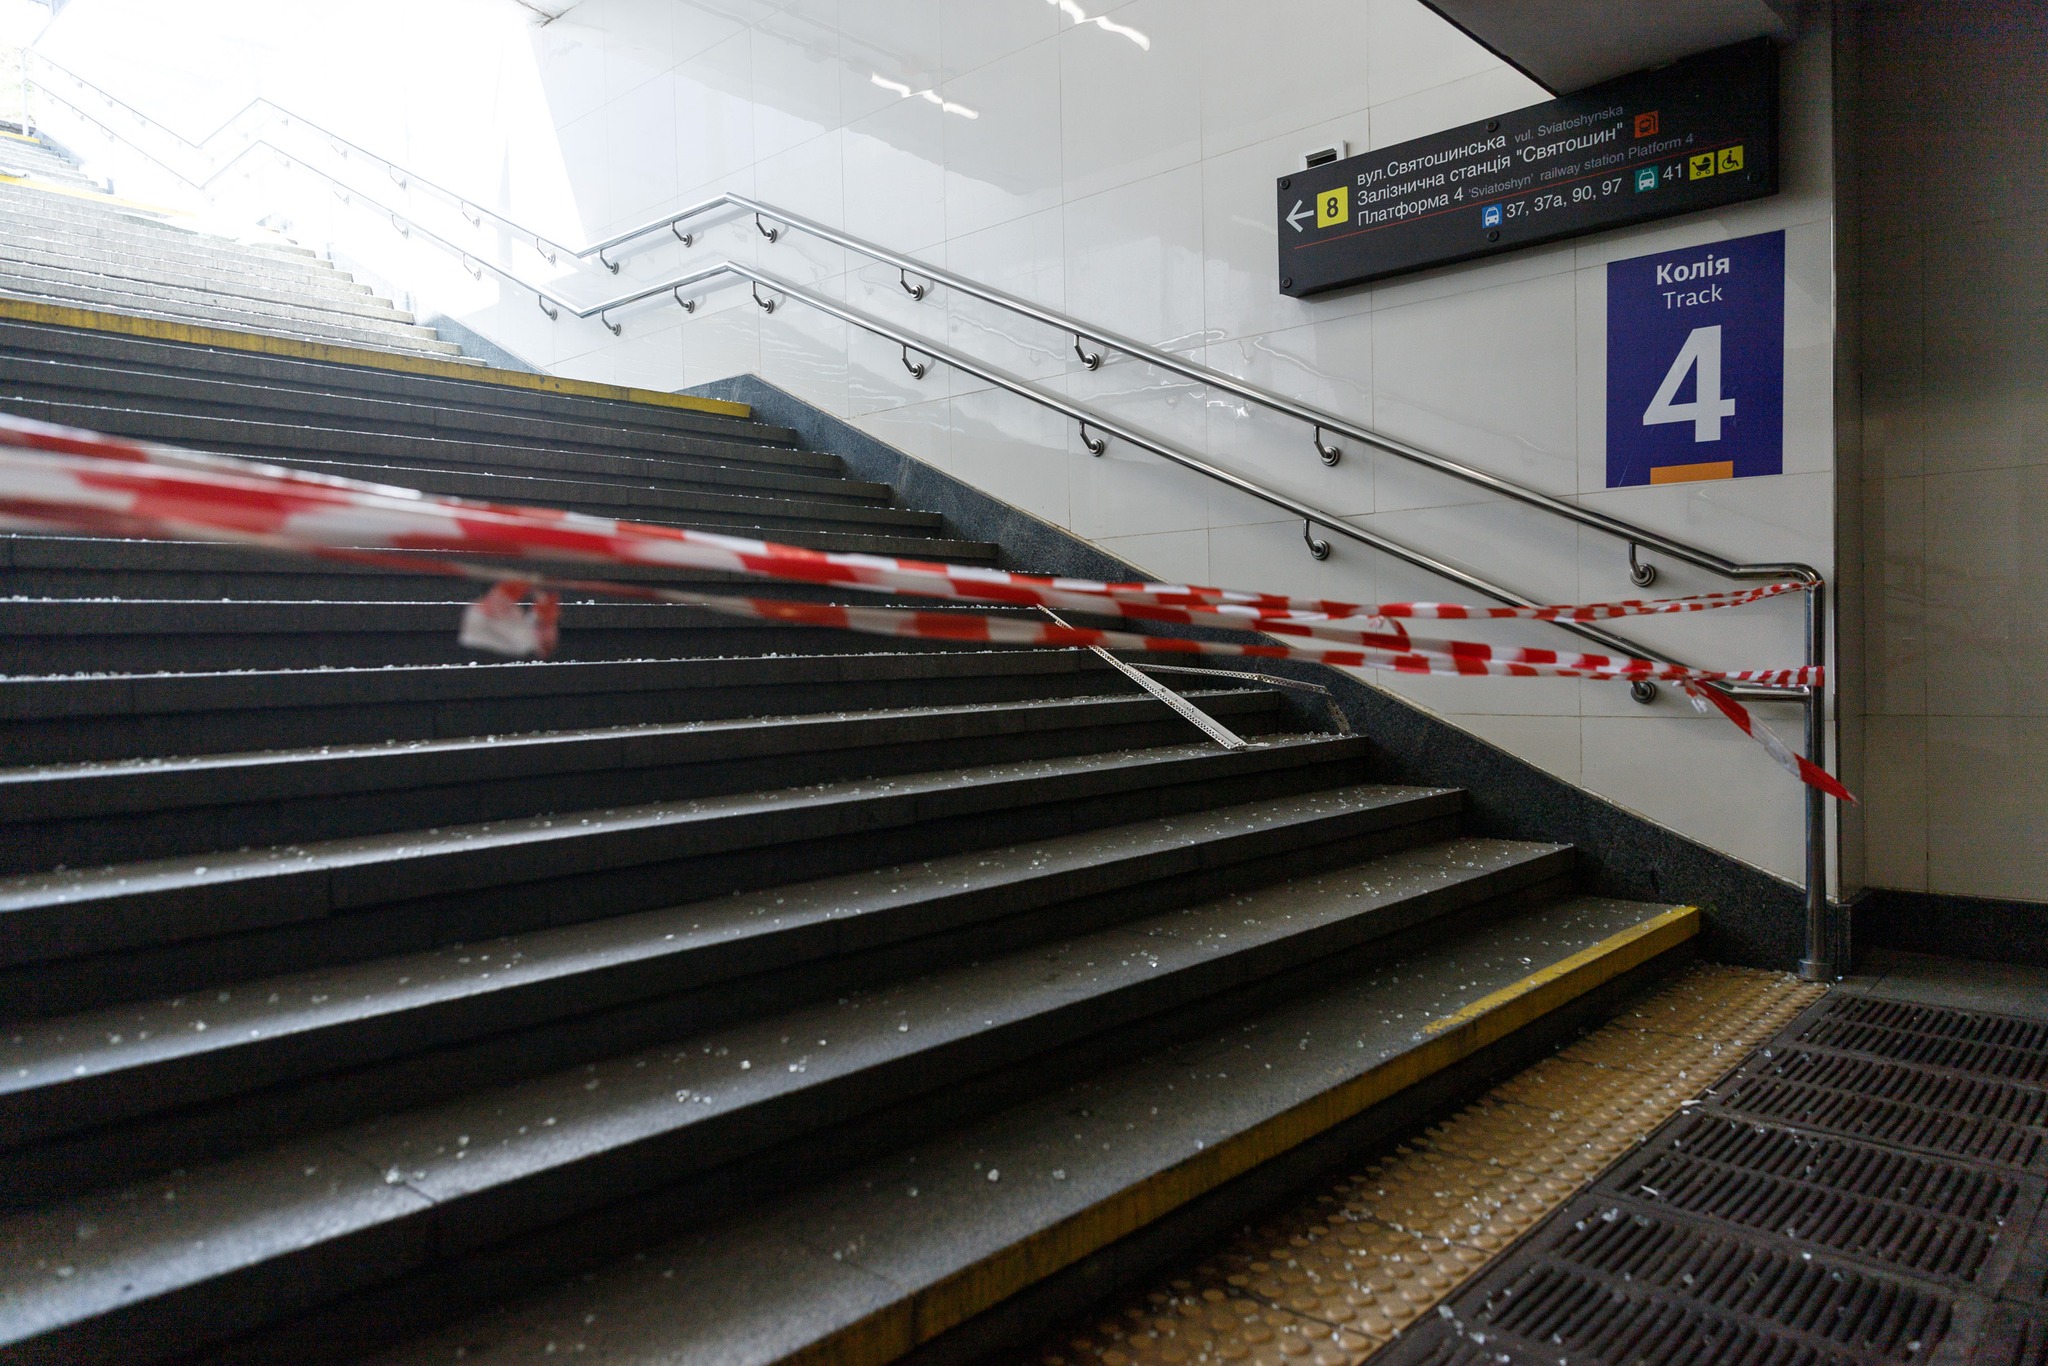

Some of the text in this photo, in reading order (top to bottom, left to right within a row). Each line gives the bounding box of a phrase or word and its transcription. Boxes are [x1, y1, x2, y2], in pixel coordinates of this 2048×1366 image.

[1514, 106, 1624, 143] vul. Sviatoshynska
[1357, 122, 1623, 206] Залізнична станція "Святошин"
[1540, 164, 1580, 181] railway
[1584, 152, 1624, 170] station
[1629, 137, 1682, 159] Platform
[1685, 133, 1694, 144] 4
[1662, 163, 1682, 181] 41
[1326, 196, 1339, 219] 8
[1358, 186, 1464, 226] Платформа 4
[1506, 201, 1529, 218] 37,
[1572, 185, 1596, 203] 90,
[1602, 178, 1622, 196] 97
[1656, 254, 1730, 286] Колія
[1662, 283, 1723, 310] Track
[1642, 324, 1736, 443] 4
